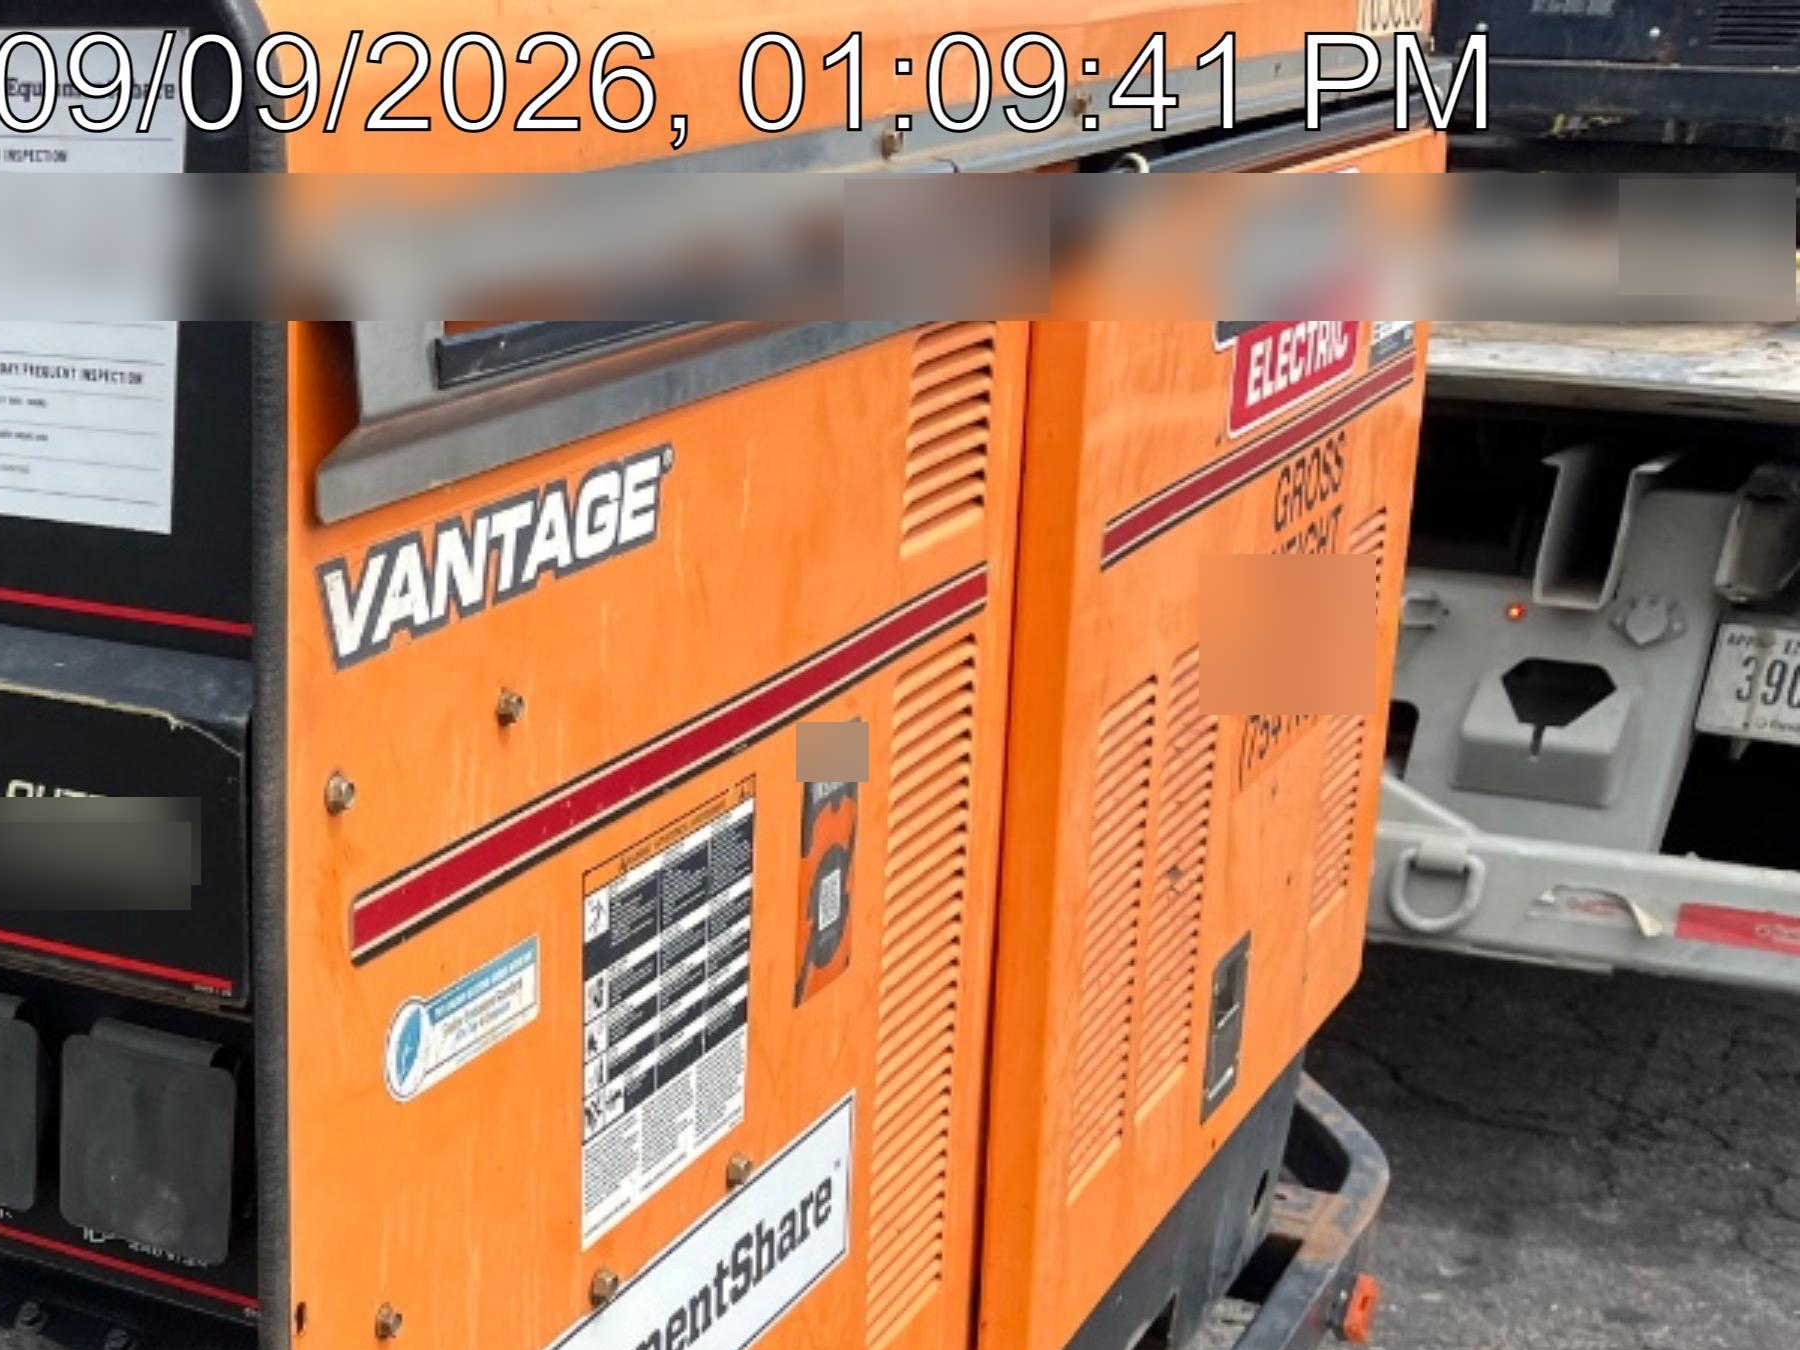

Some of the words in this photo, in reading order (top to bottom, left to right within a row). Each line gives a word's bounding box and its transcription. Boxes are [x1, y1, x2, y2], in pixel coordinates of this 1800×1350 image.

[1245, 321, 1350, 409] ELECTRIC
[1273, 429, 1346, 532] GROSS
[318, 448, 666, 664] VANTAGE
